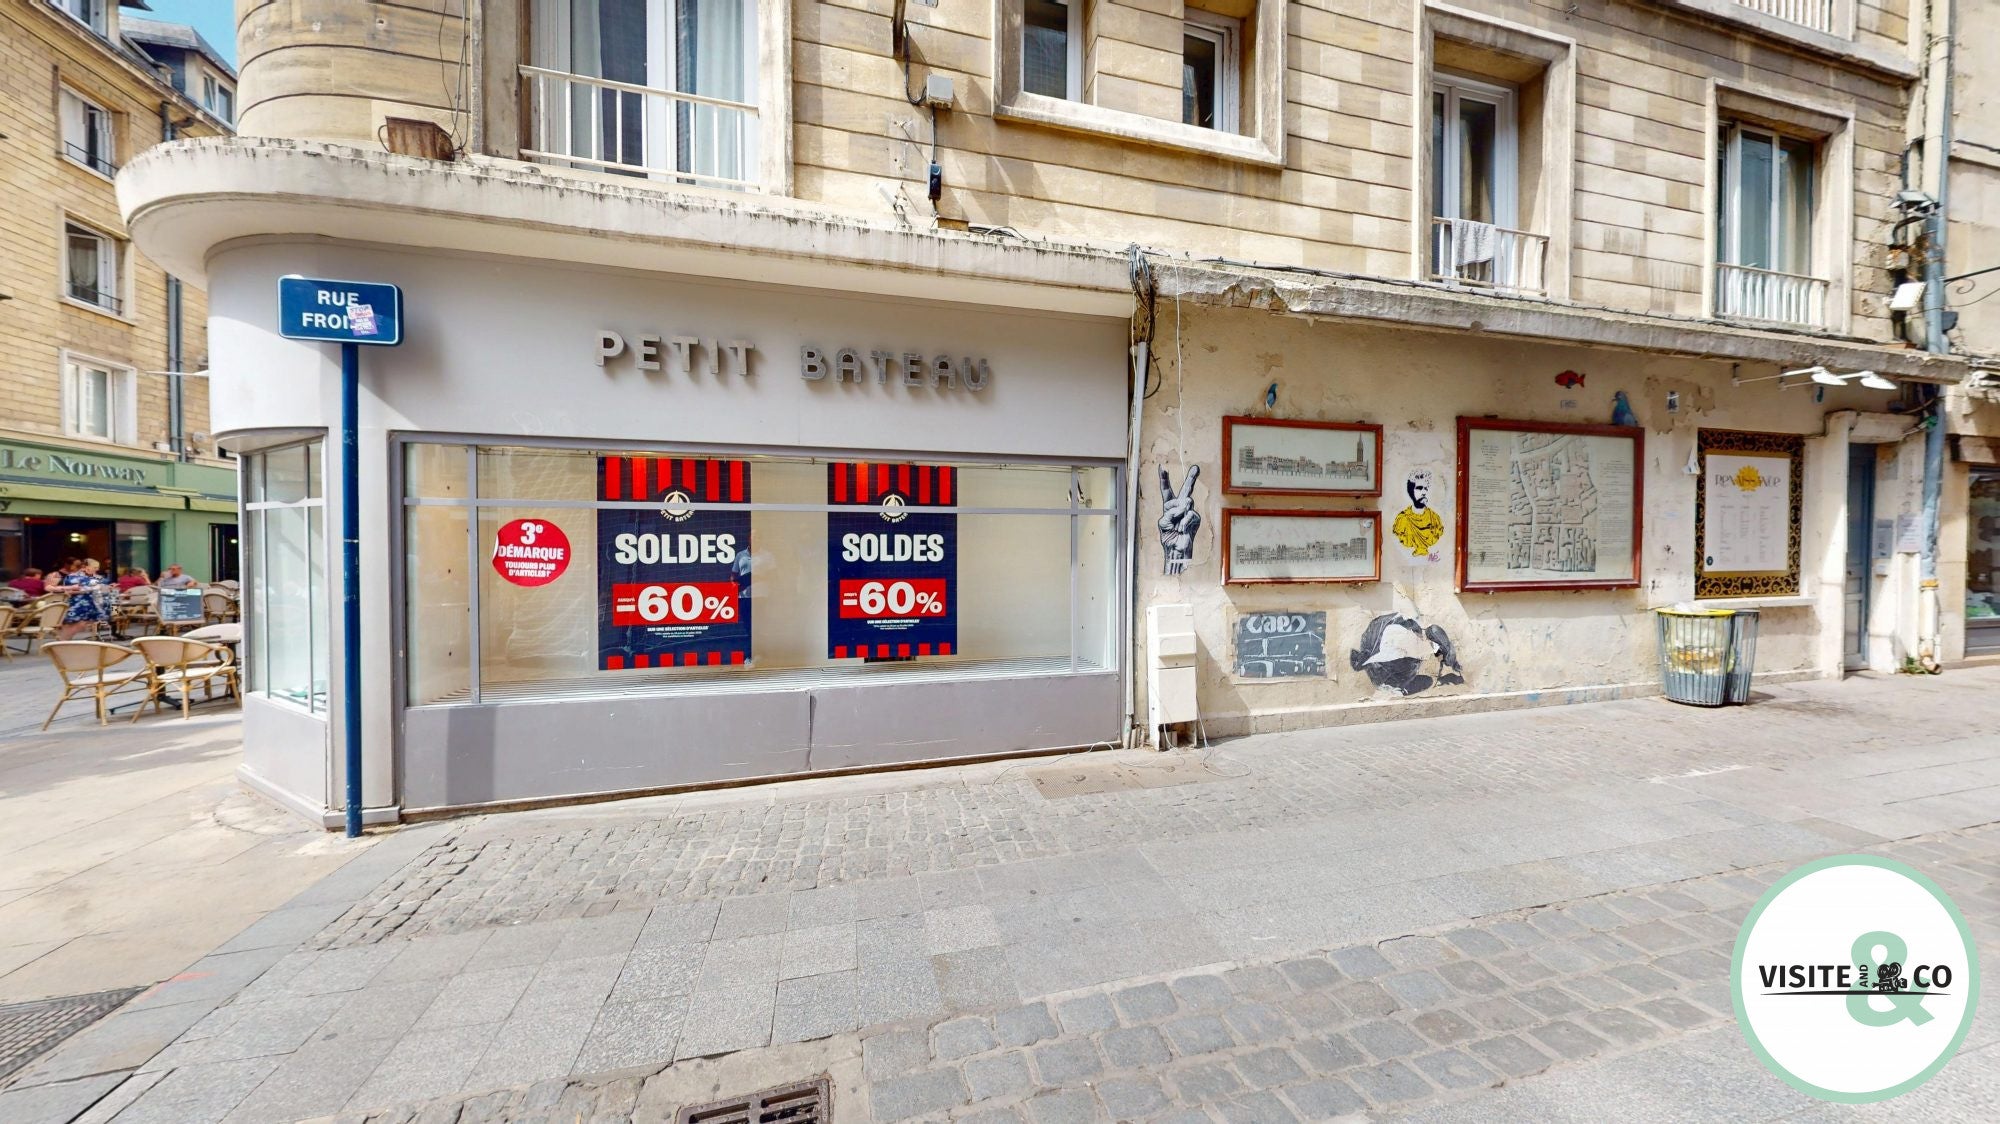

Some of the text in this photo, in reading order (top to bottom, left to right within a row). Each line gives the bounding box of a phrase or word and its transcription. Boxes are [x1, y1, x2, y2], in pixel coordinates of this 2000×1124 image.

[317, 290, 360, 306] RUE
[302, 312, 360, 330] FROI
[596, 330, 990, 392] PETIT BATEAU
[2, 449, 147, 486] Le Norway
[660, 509, 695, 522] ETIT BATEA
[891, 512, 909, 523] BATEA
[498, 544, 564, 561] DÉMARQUE
[614, 533, 736, 565] SOLDES
[842, 533, 945, 562] SOLDES
[505, 561, 556, 571] TOUJOURS PLUS
